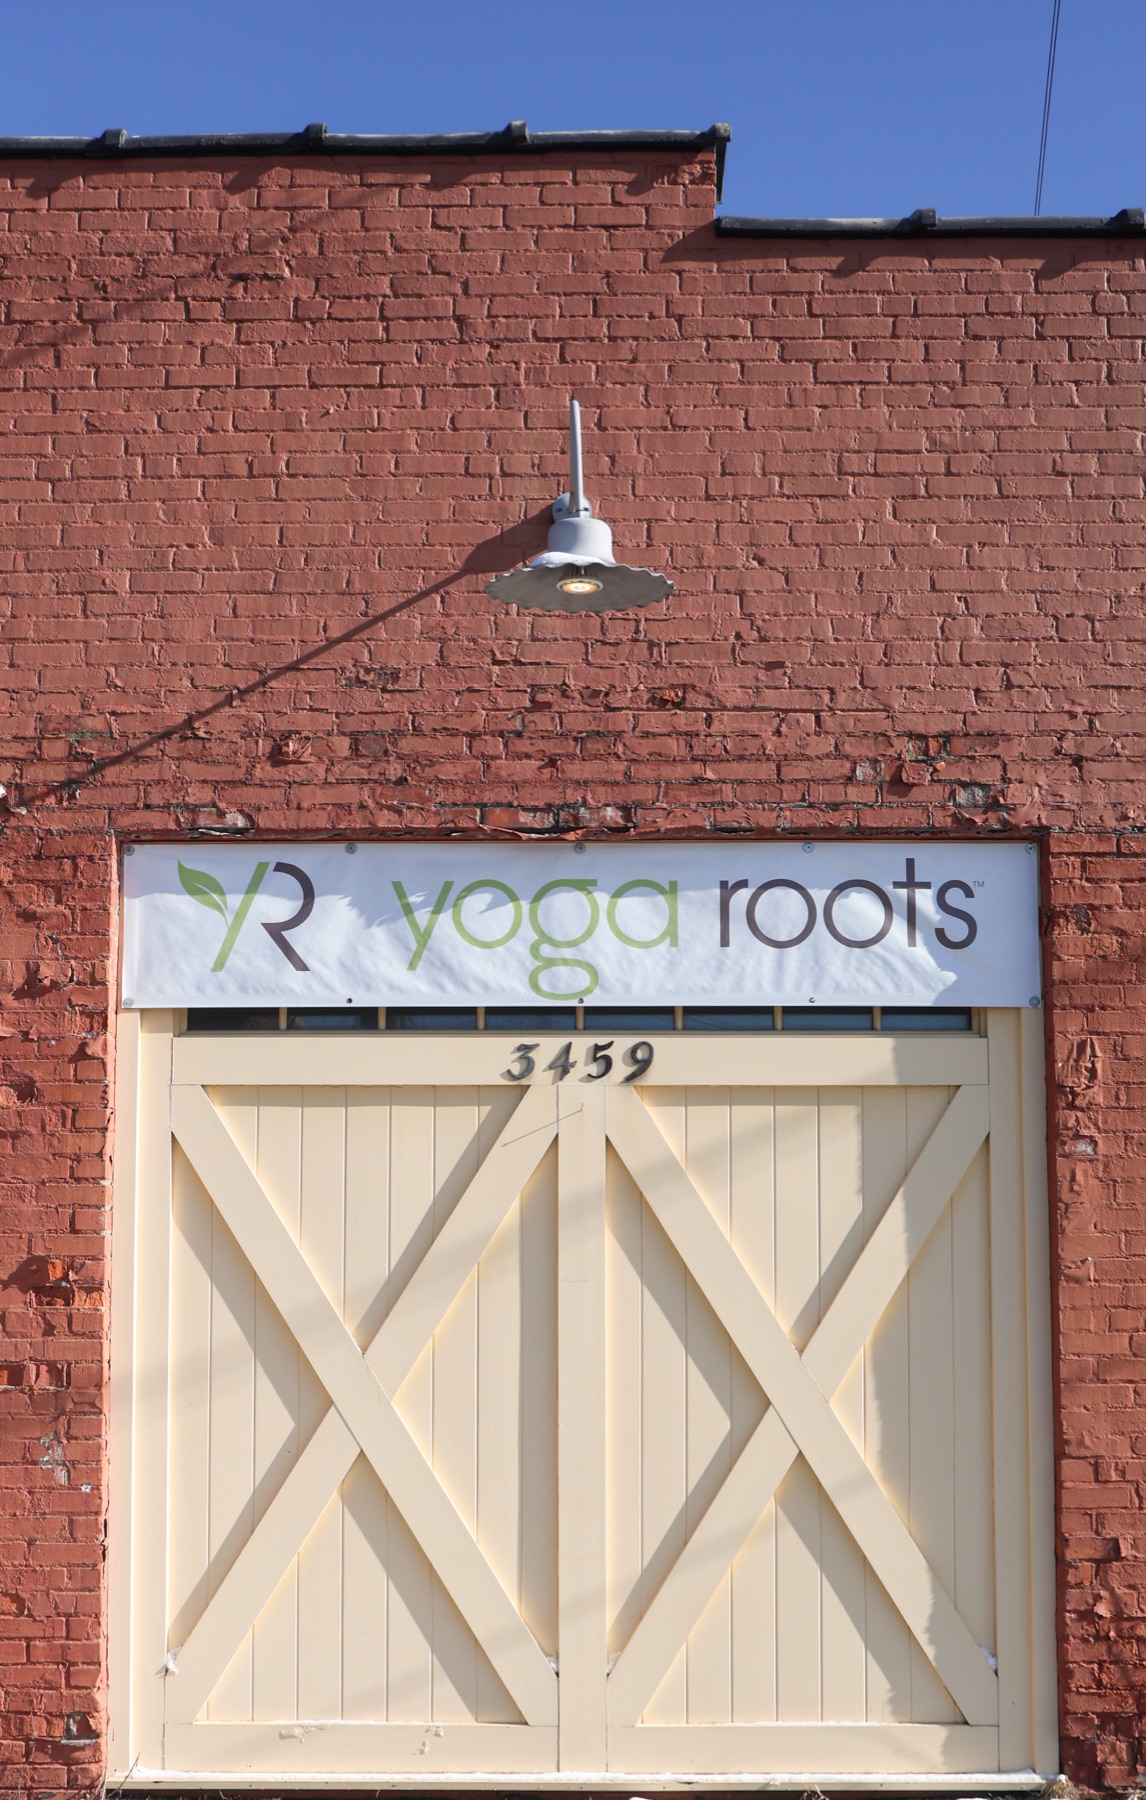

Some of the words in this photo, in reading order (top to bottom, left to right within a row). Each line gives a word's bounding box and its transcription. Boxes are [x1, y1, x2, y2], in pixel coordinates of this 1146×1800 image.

[391, 878, 678, 1001] yoga
[719, 857, 978, 950] roots
[506, 1040, 655, 1083] 3459
